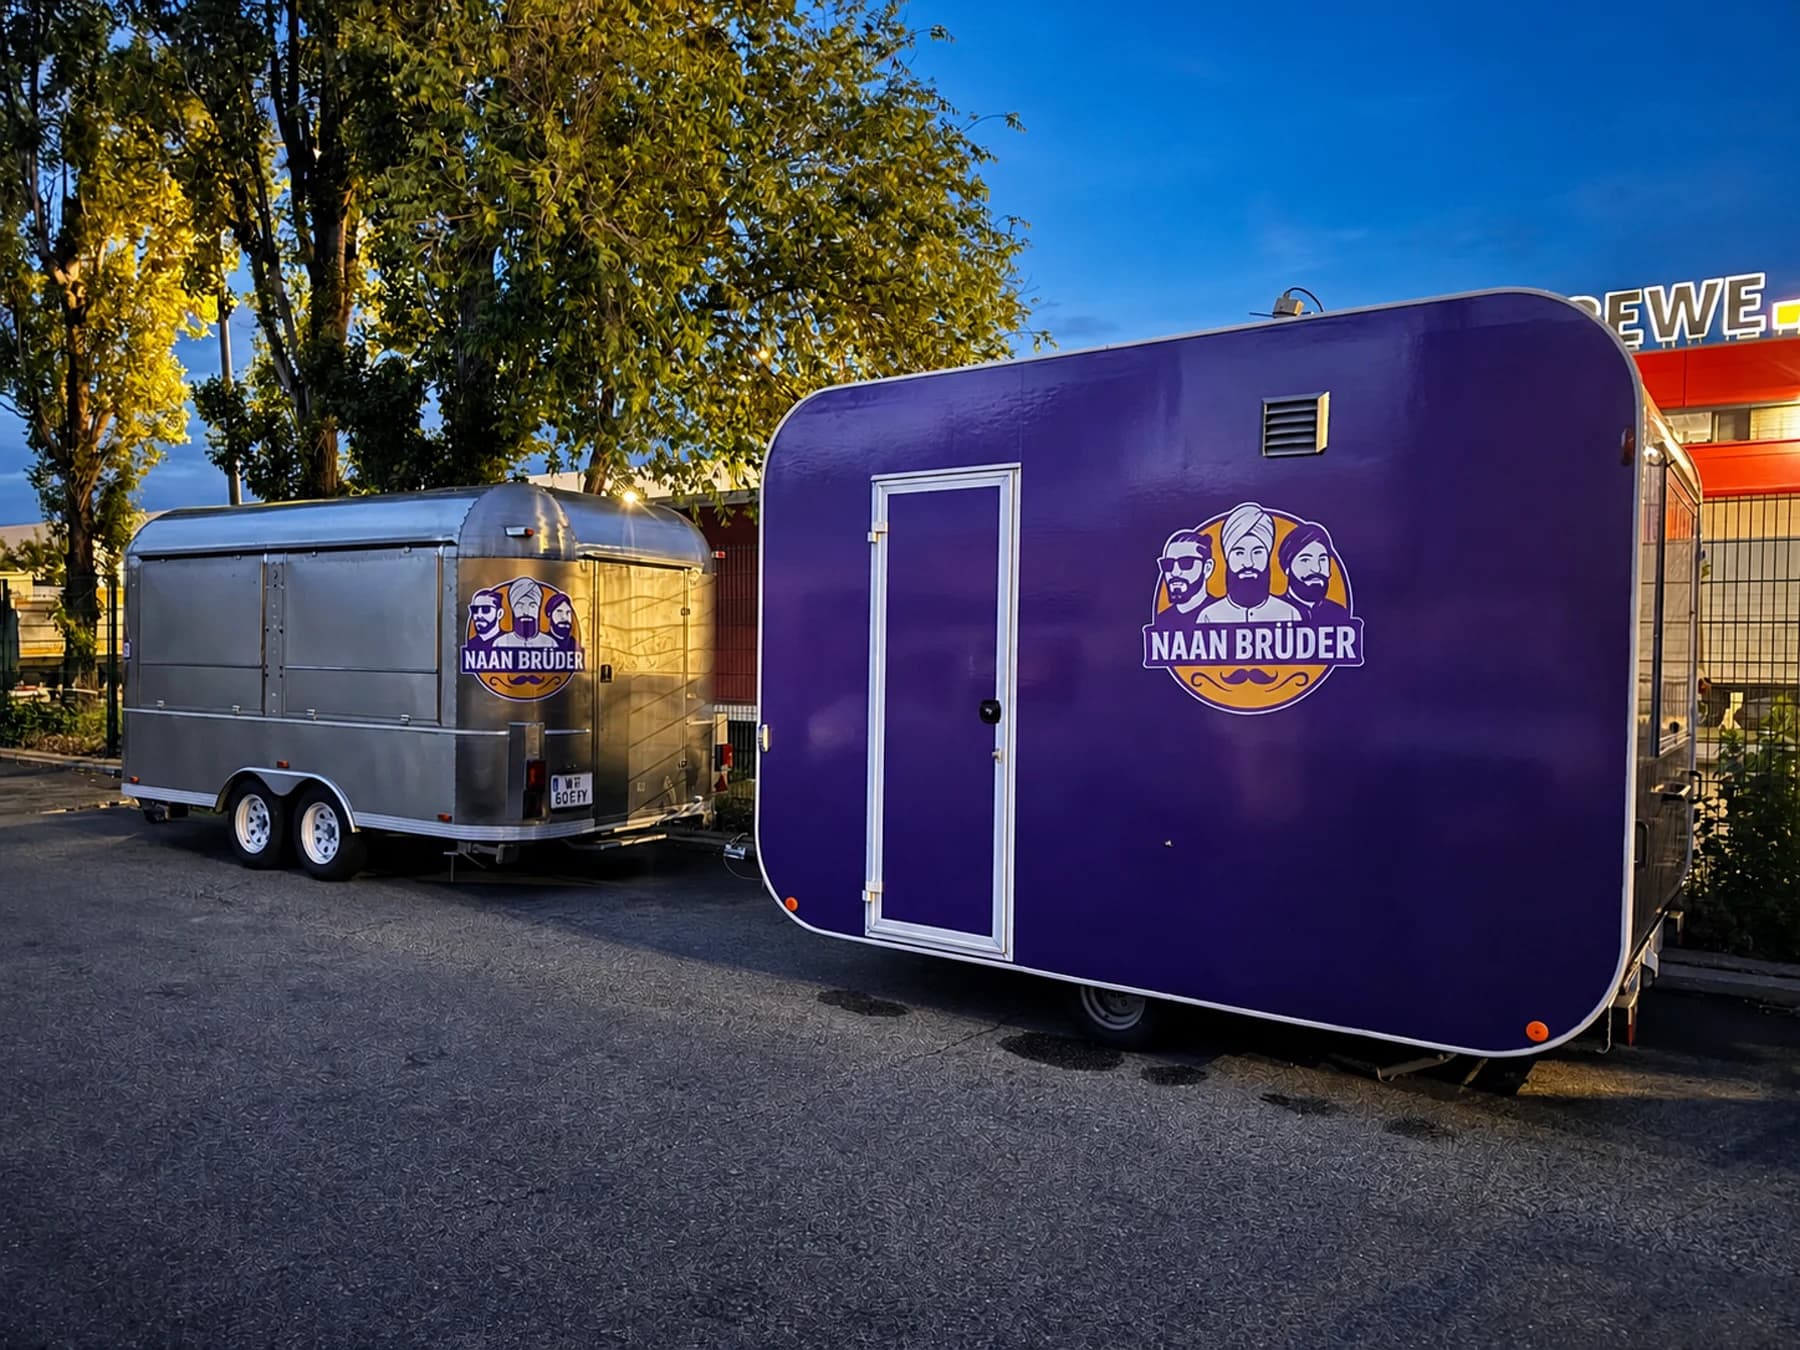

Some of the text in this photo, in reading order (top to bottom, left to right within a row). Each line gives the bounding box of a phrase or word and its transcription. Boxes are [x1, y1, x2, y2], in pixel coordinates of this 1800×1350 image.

[1151, 622, 1356, 660] NAAN BRÜDER
[465, 648, 584, 670] NAAN BRÜDER
